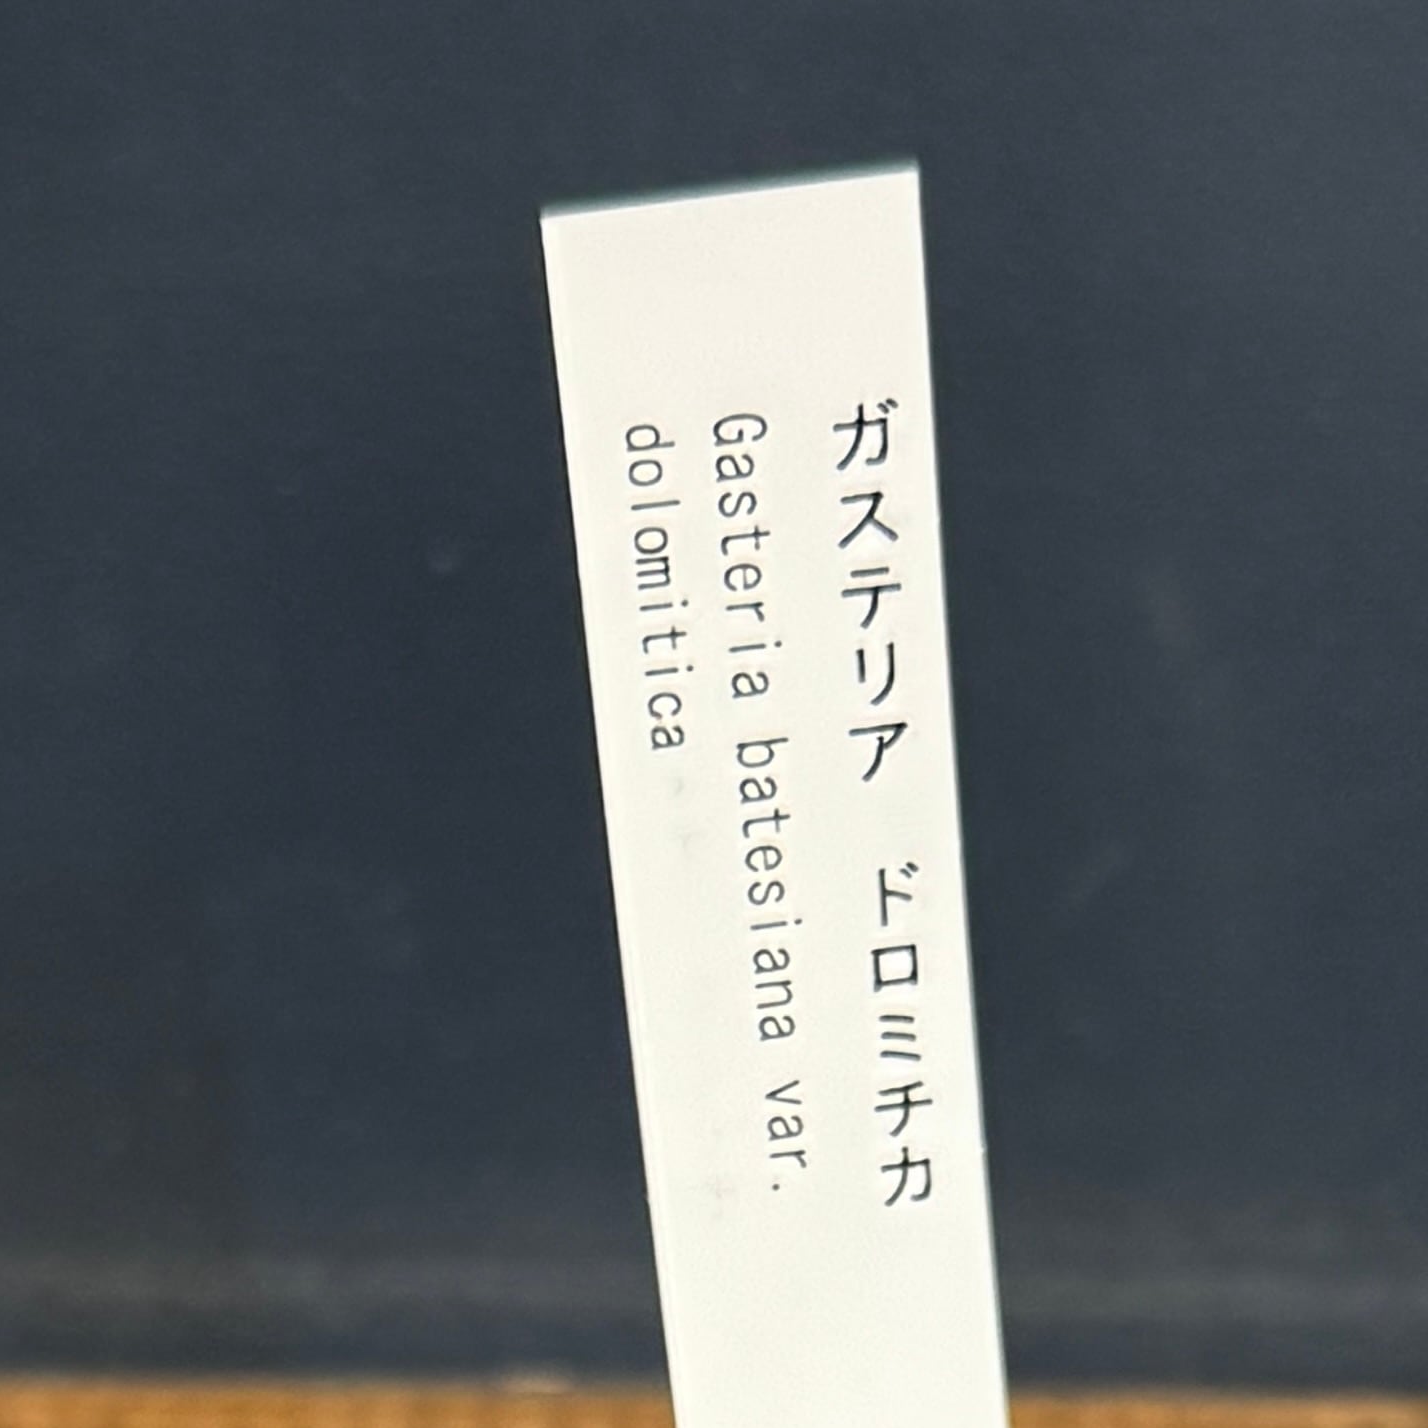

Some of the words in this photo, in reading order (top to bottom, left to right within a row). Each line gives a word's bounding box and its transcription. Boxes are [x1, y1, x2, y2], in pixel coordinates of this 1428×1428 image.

[625, 423, 694, 750] dolomitica
[712, 412, 783, 700] Gasteria
[736, 737, 803, 1042] batesiana
[832, 398, 908, 783] ガステリア
[870, 862, 933, 1207] ドロミチカ
[765, 1079, 808, 1191] var.
